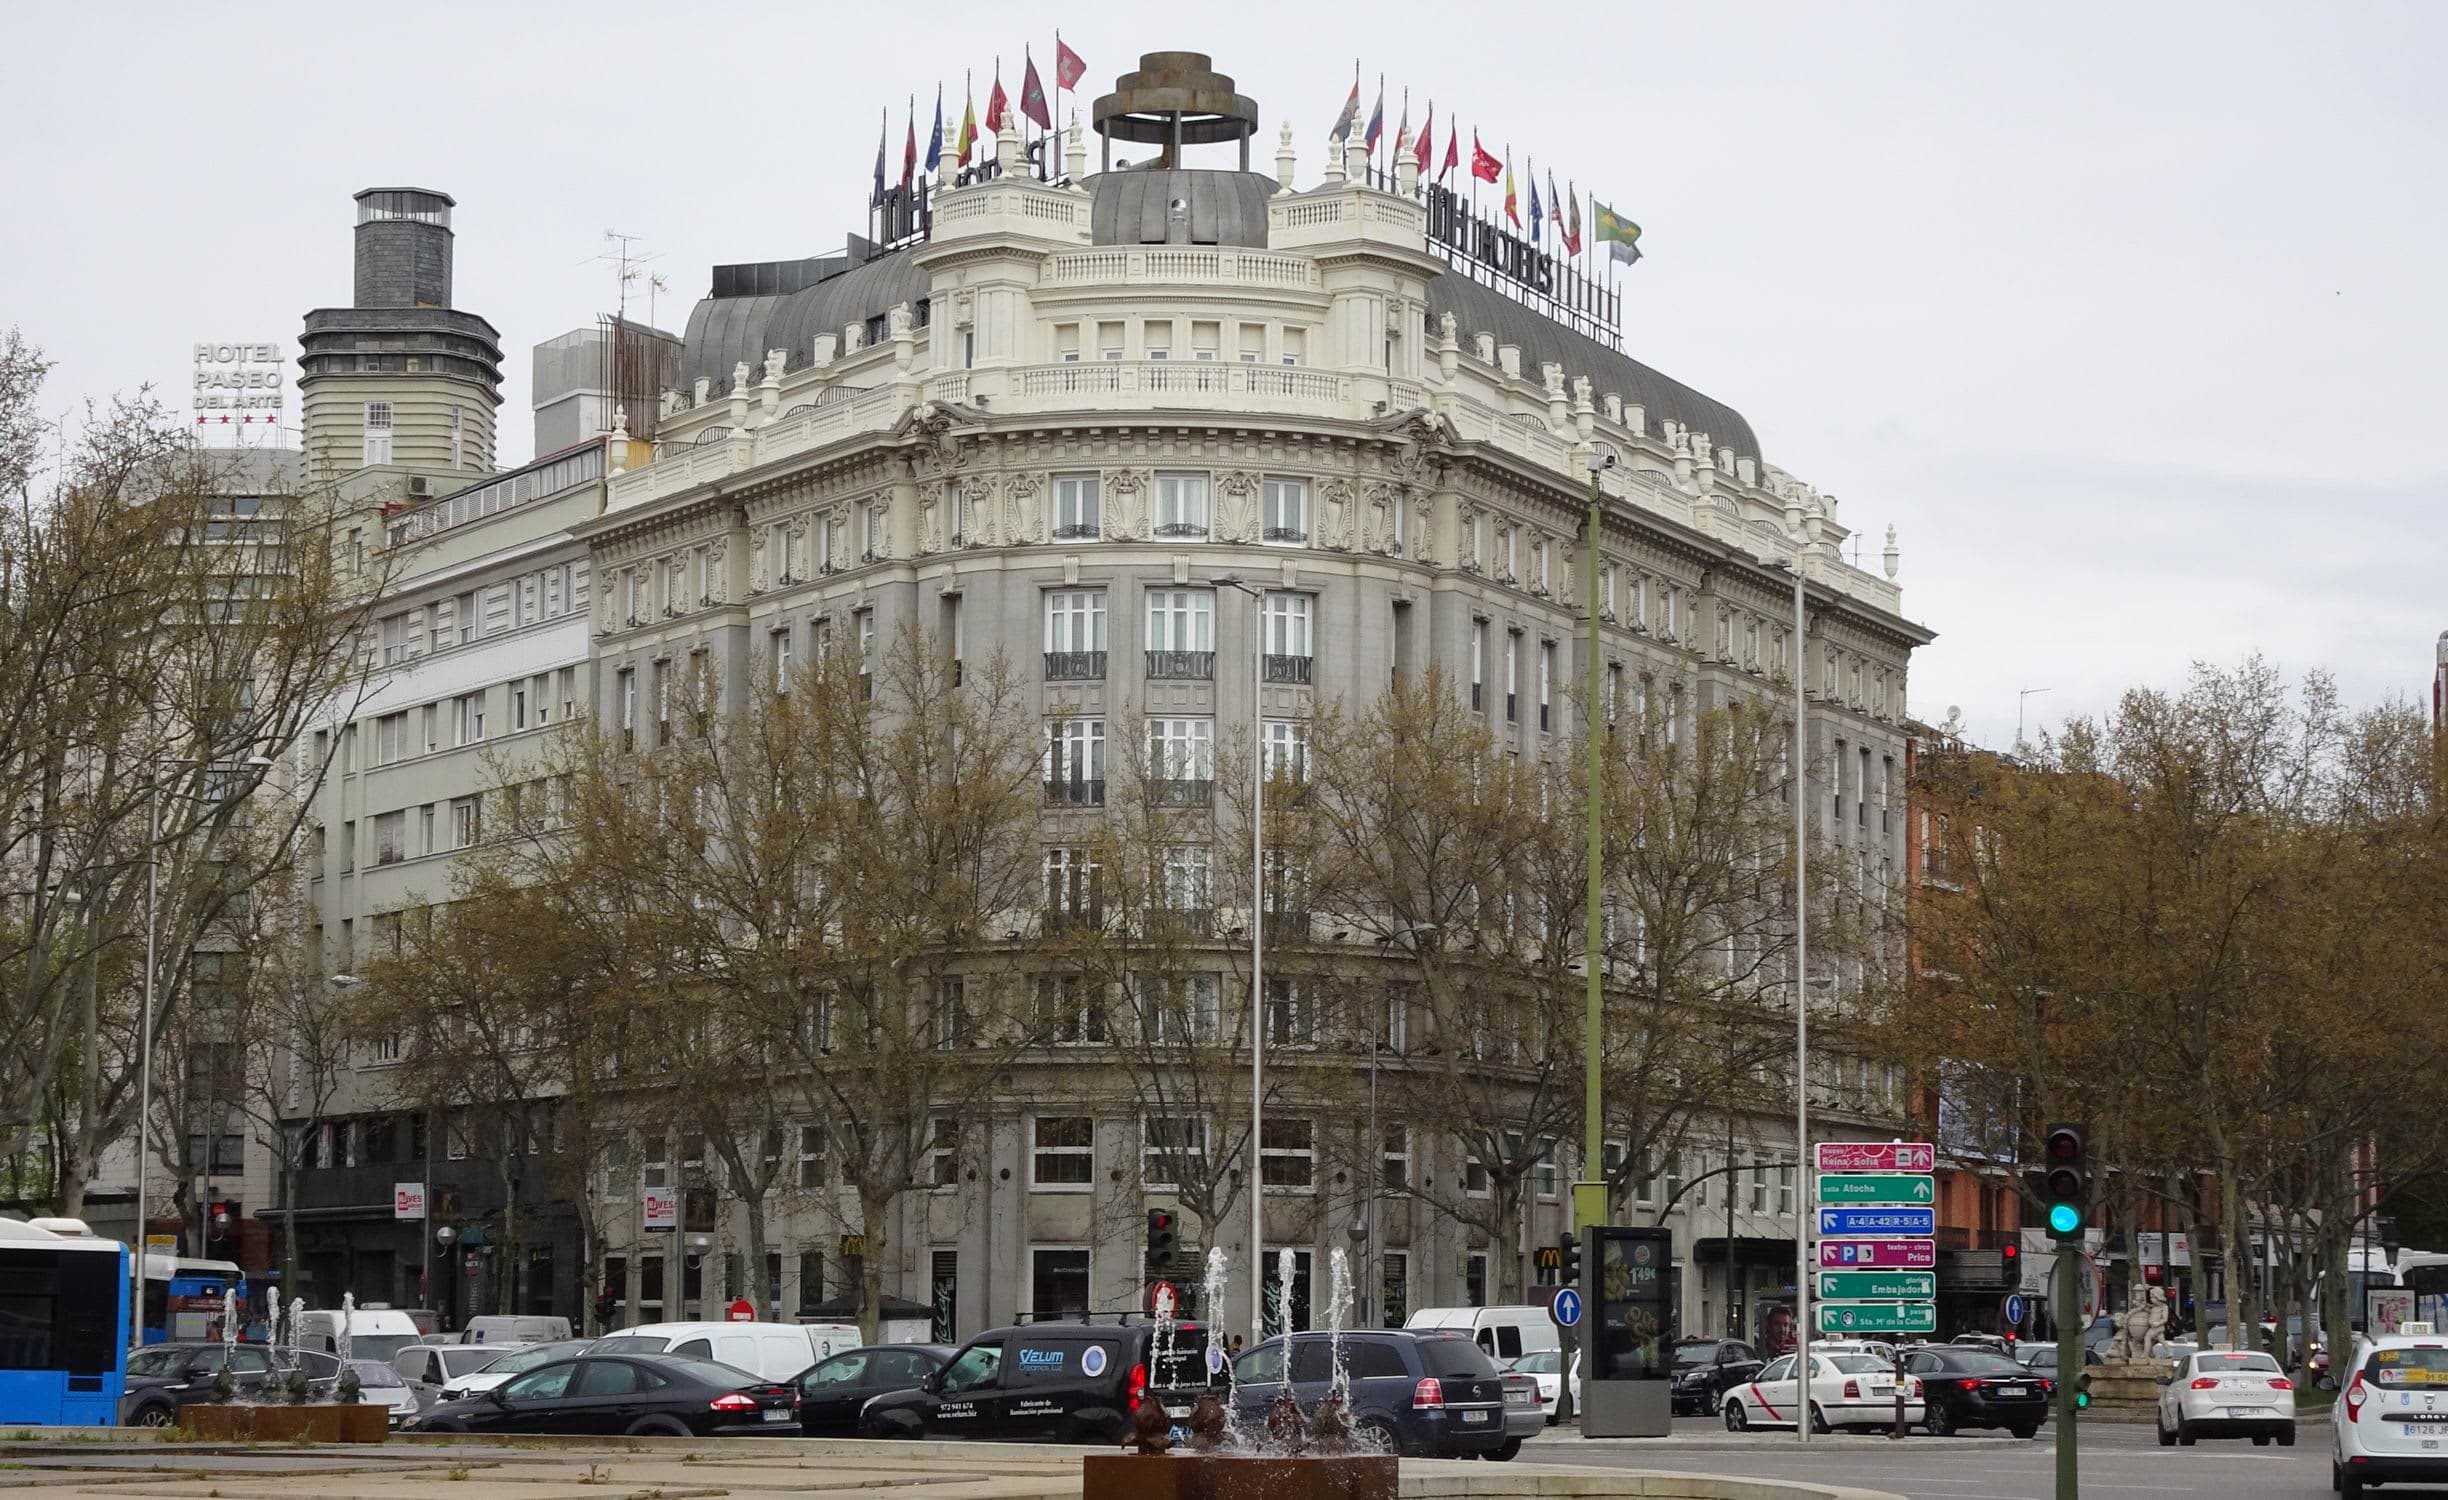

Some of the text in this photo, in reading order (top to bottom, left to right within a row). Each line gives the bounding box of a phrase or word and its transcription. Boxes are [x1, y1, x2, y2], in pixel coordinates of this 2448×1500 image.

[194, 343, 285, 363] HOTEL
[193, 370, 283, 389] PASEO
[193, 395, 283, 409] DEL ARTE
[1822, 1157, 1848, 1165] Reina
[1843, 1184, 1875, 1193] Atocha
[1849, 1217, 1929, 1226] A-4 A-42 R-5 A-5
[1843, 1247, 1855, 1261] P
[1907, 1253, 1931, 1261] Price
[1871, 1285, 1931, 1295] Embajador
[2410, 1425, 2435, 1434] 6126
